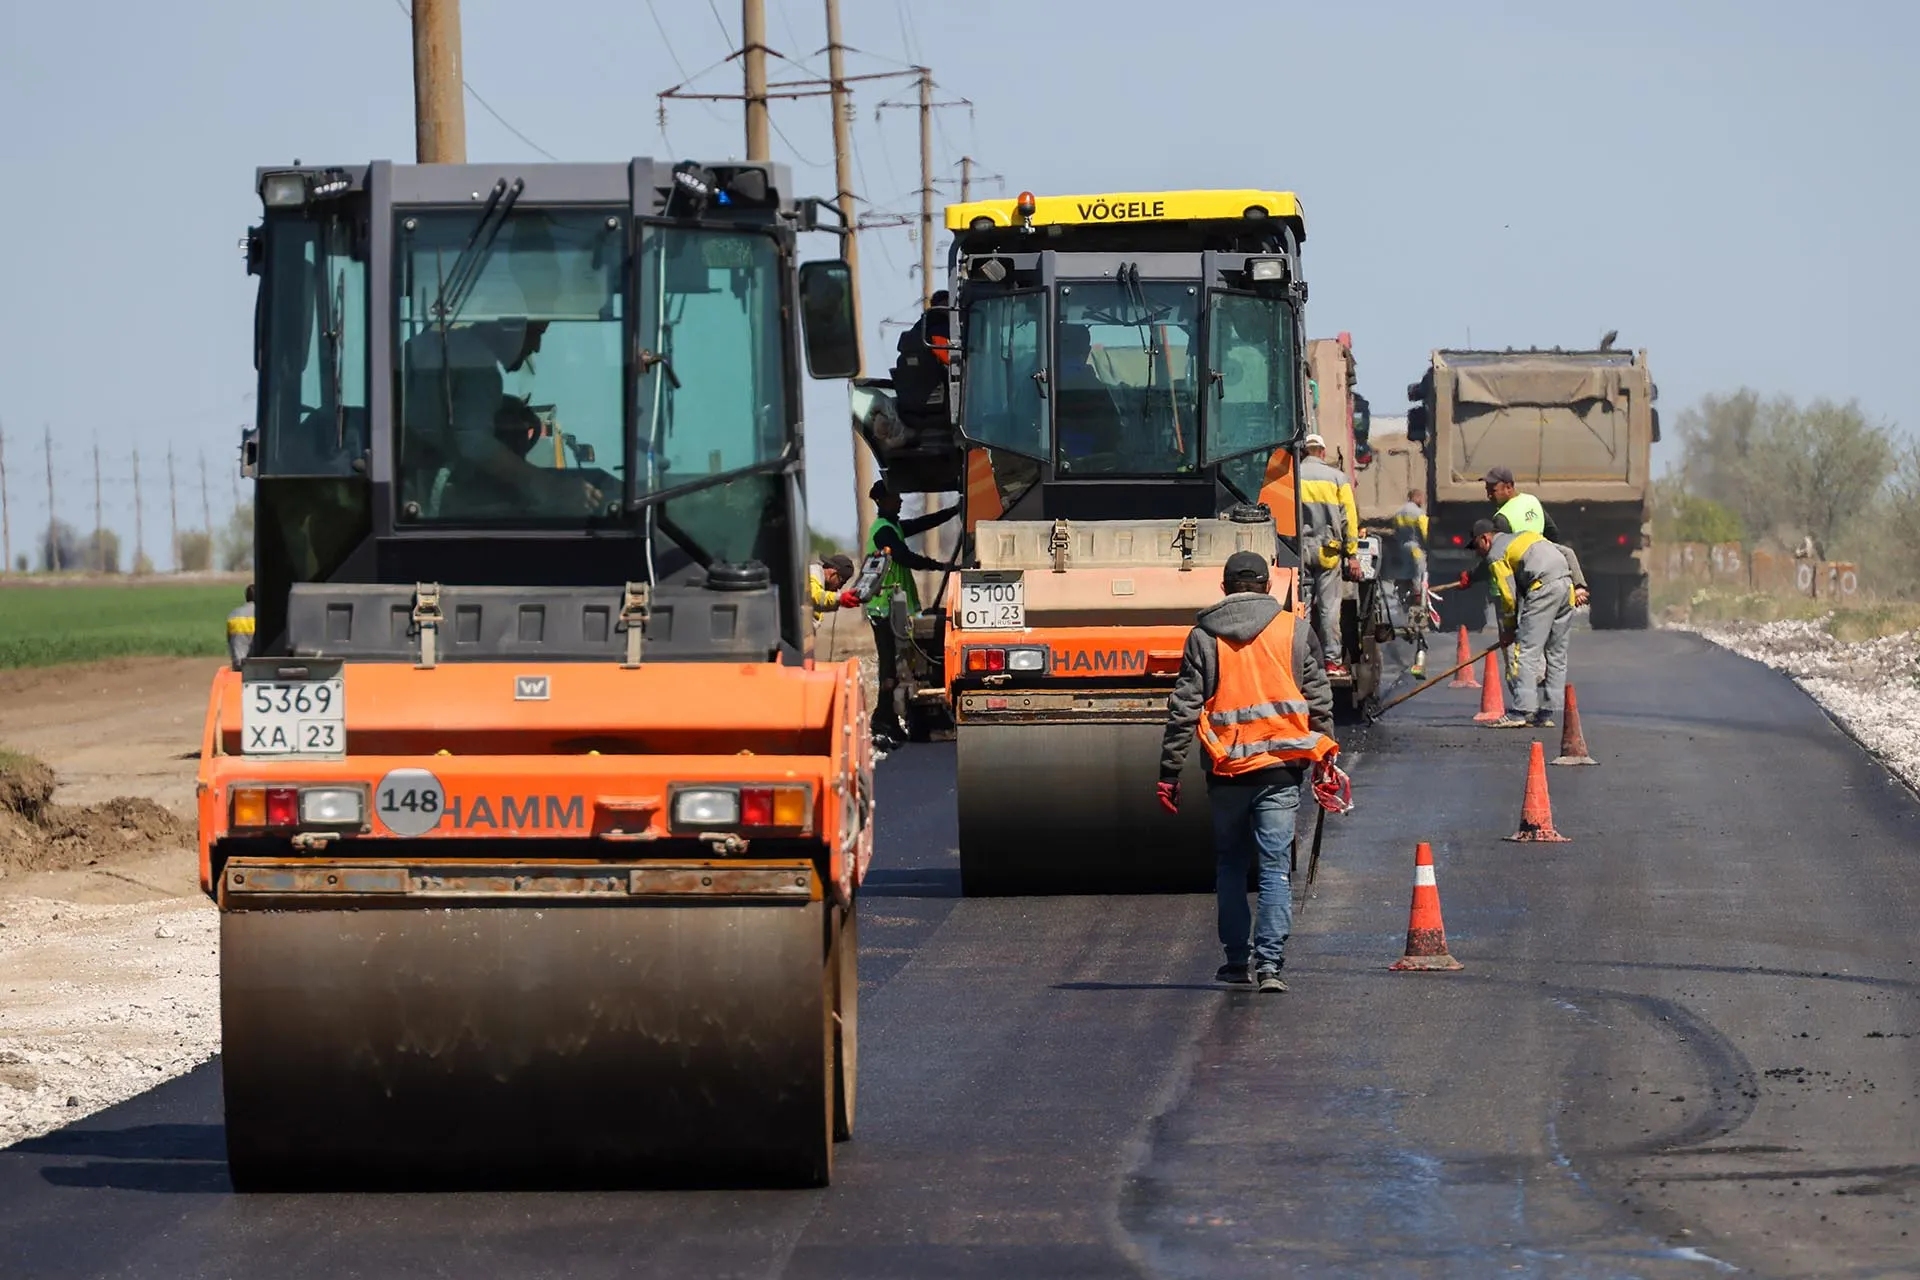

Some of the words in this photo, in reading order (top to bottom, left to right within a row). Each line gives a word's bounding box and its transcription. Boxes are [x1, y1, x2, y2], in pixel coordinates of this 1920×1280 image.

[1077, 198, 1164, 220] VÖGELE
[970, 584, 1015, 603] 5100
[1001, 605, 1019, 620] 23
[1052, 649, 1145, 671] HAMM
[256, 684, 331, 713] 5369
[307, 725, 335, 747] 23
[381, 788, 439, 813] 148
[434, 795, 584, 829] HAMM
